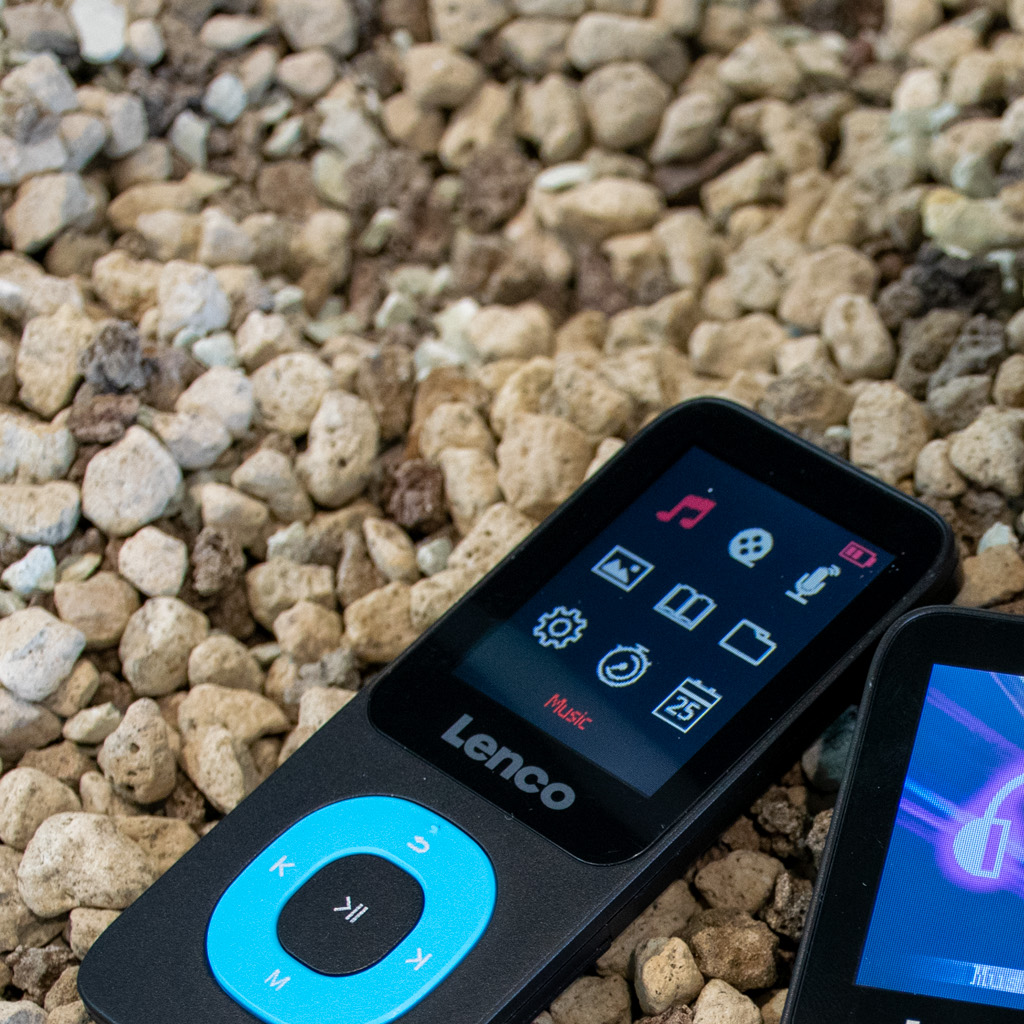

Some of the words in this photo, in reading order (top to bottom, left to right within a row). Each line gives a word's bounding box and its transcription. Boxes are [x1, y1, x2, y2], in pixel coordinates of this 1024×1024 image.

[544, 693, 592, 731] Music
[665, 697, 700, 721] 25
[440, 713, 576, 811] Lenco
[264, 969, 291, 991] M
